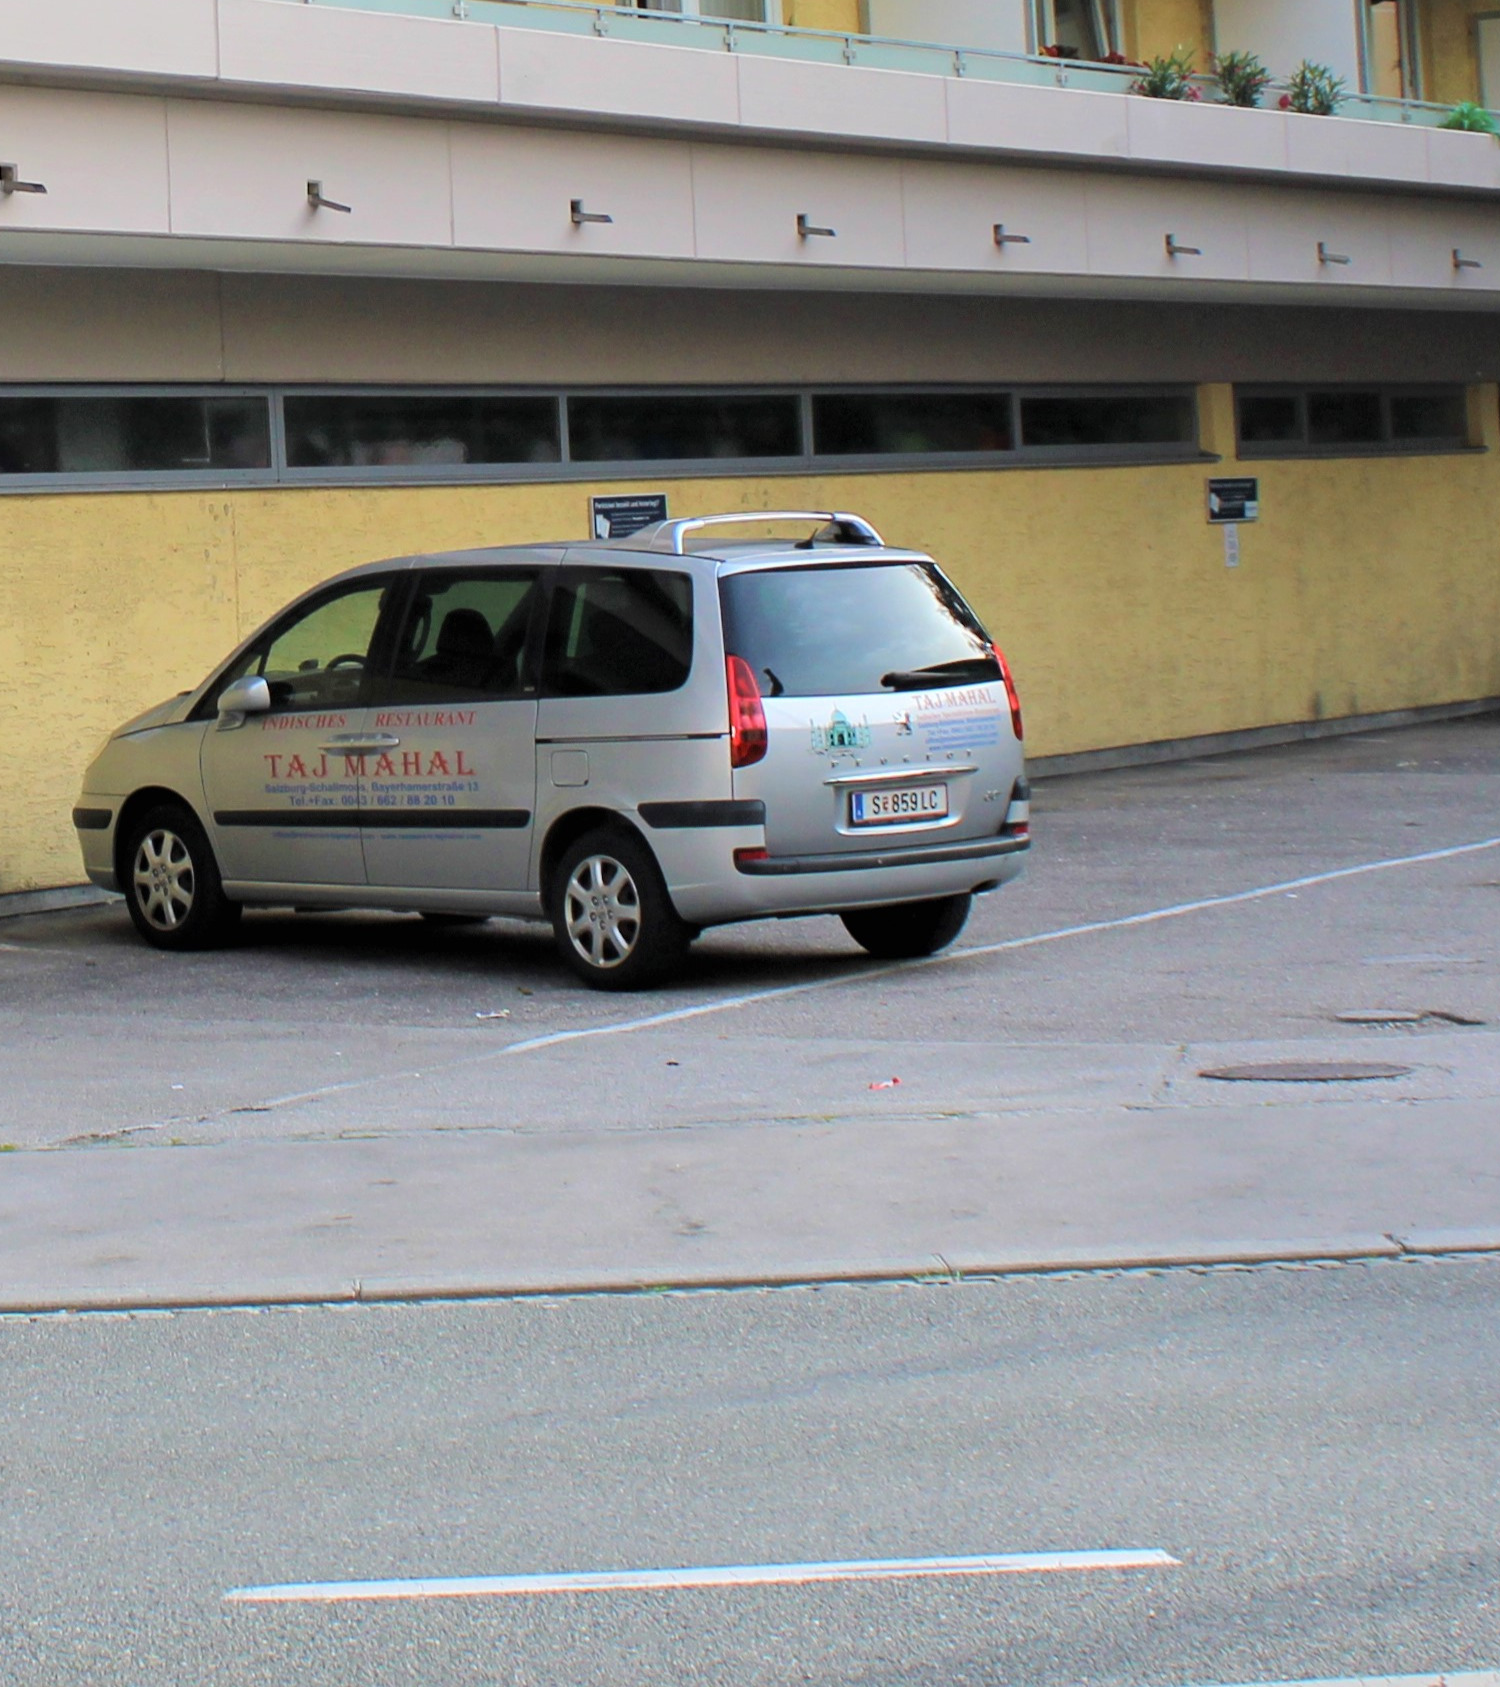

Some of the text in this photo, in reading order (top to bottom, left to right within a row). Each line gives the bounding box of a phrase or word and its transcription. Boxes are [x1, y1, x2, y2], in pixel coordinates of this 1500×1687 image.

[911, 688, 997, 711] TAJ MAHAL
[262, 711, 477, 731] INDISCHES RESTAURANT
[264, 750, 477, 779] TAJ MAHAL
[467, 781, 479, 792] 13
[341, 794, 368, 806] 0043
[377, 794, 397, 806] 662
[424, 794, 438, 806] 20
[442, 794, 455, 806] 10
[872, 790, 938, 815] S 859 LC
